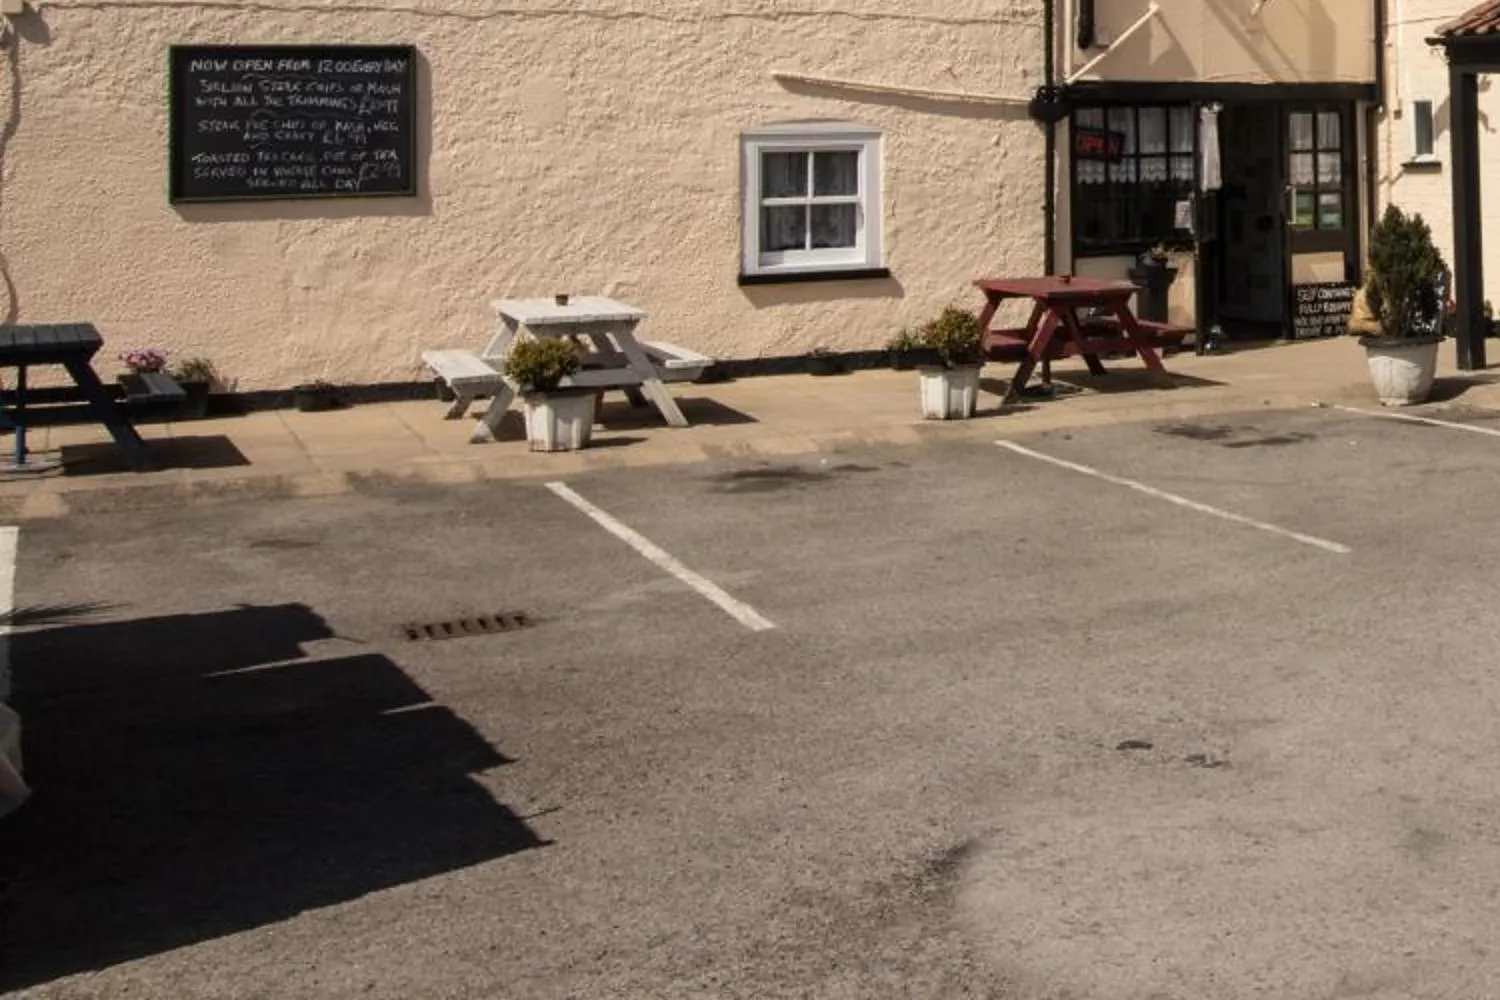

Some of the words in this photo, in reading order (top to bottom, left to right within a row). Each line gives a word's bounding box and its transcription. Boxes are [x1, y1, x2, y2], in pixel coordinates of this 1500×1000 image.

[191, 59, 227, 72] NOW
[233, 59, 272, 71] OPEN
[277, 59, 310, 71] FROM
[233, 96, 258, 107] ALL
[1076, 134, 1119, 157] OPEN
